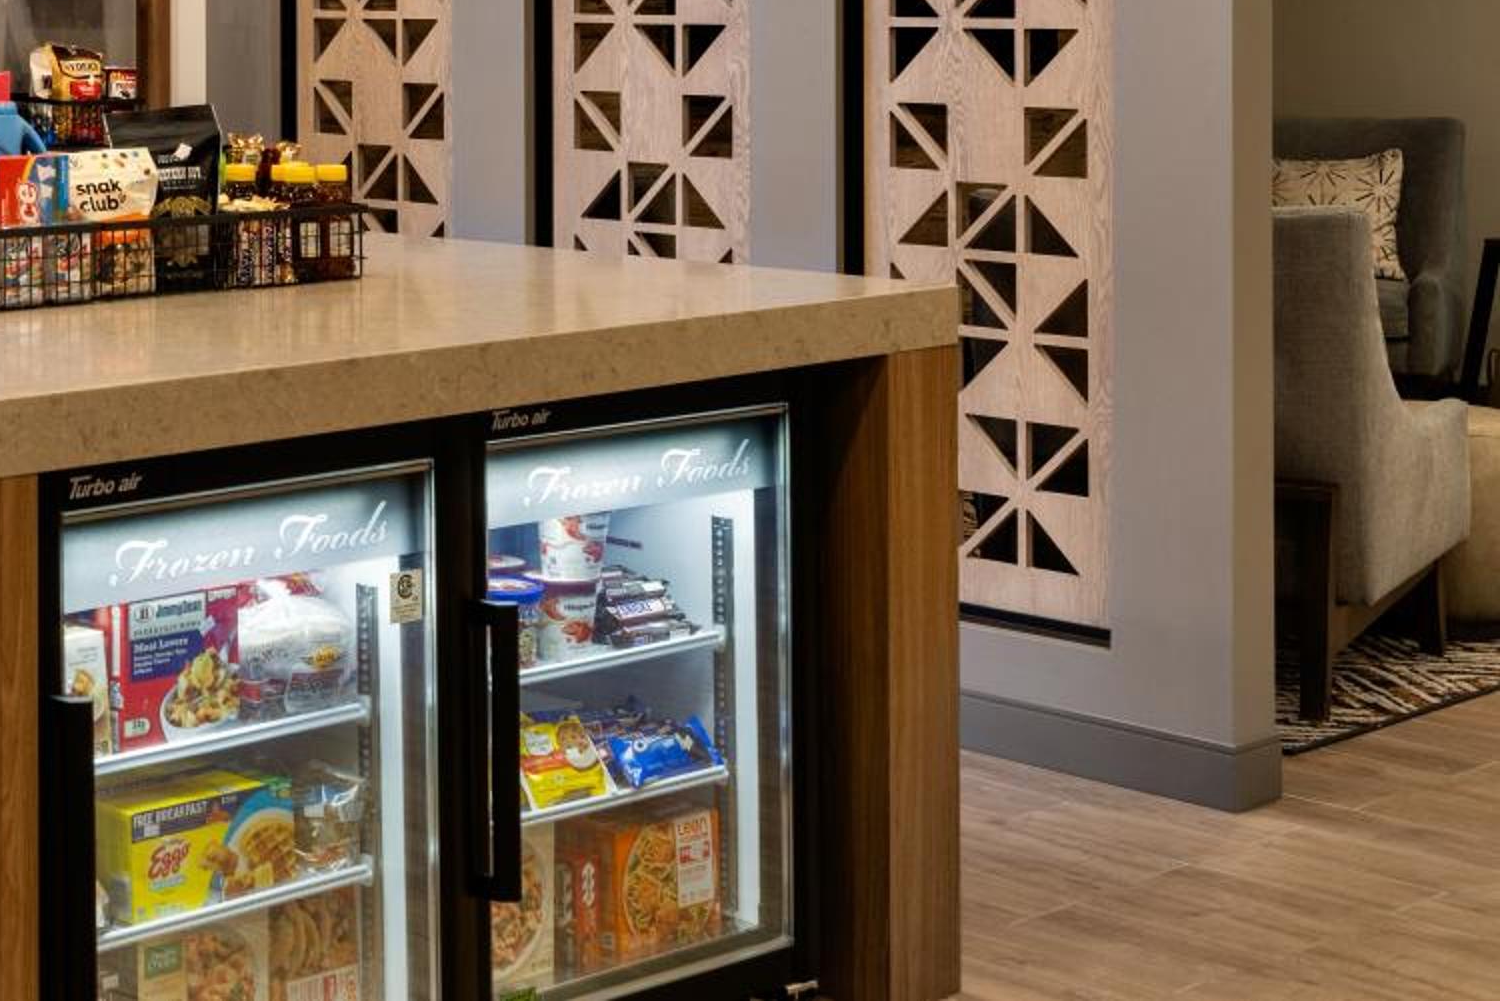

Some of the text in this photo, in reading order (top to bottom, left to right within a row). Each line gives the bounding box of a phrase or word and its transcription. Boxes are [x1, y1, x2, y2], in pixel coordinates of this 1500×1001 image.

[75, 179, 122, 196] snak
[79, 194, 120, 213] club
[492, 408, 551, 431] Turbo air
[69, 471, 143, 500] Turbo air
[523, 439, 750, 507] Frozen Foods
[108, 500, 389, 587] Frozen Foods
[147, 840, 191, 880] Eggo
